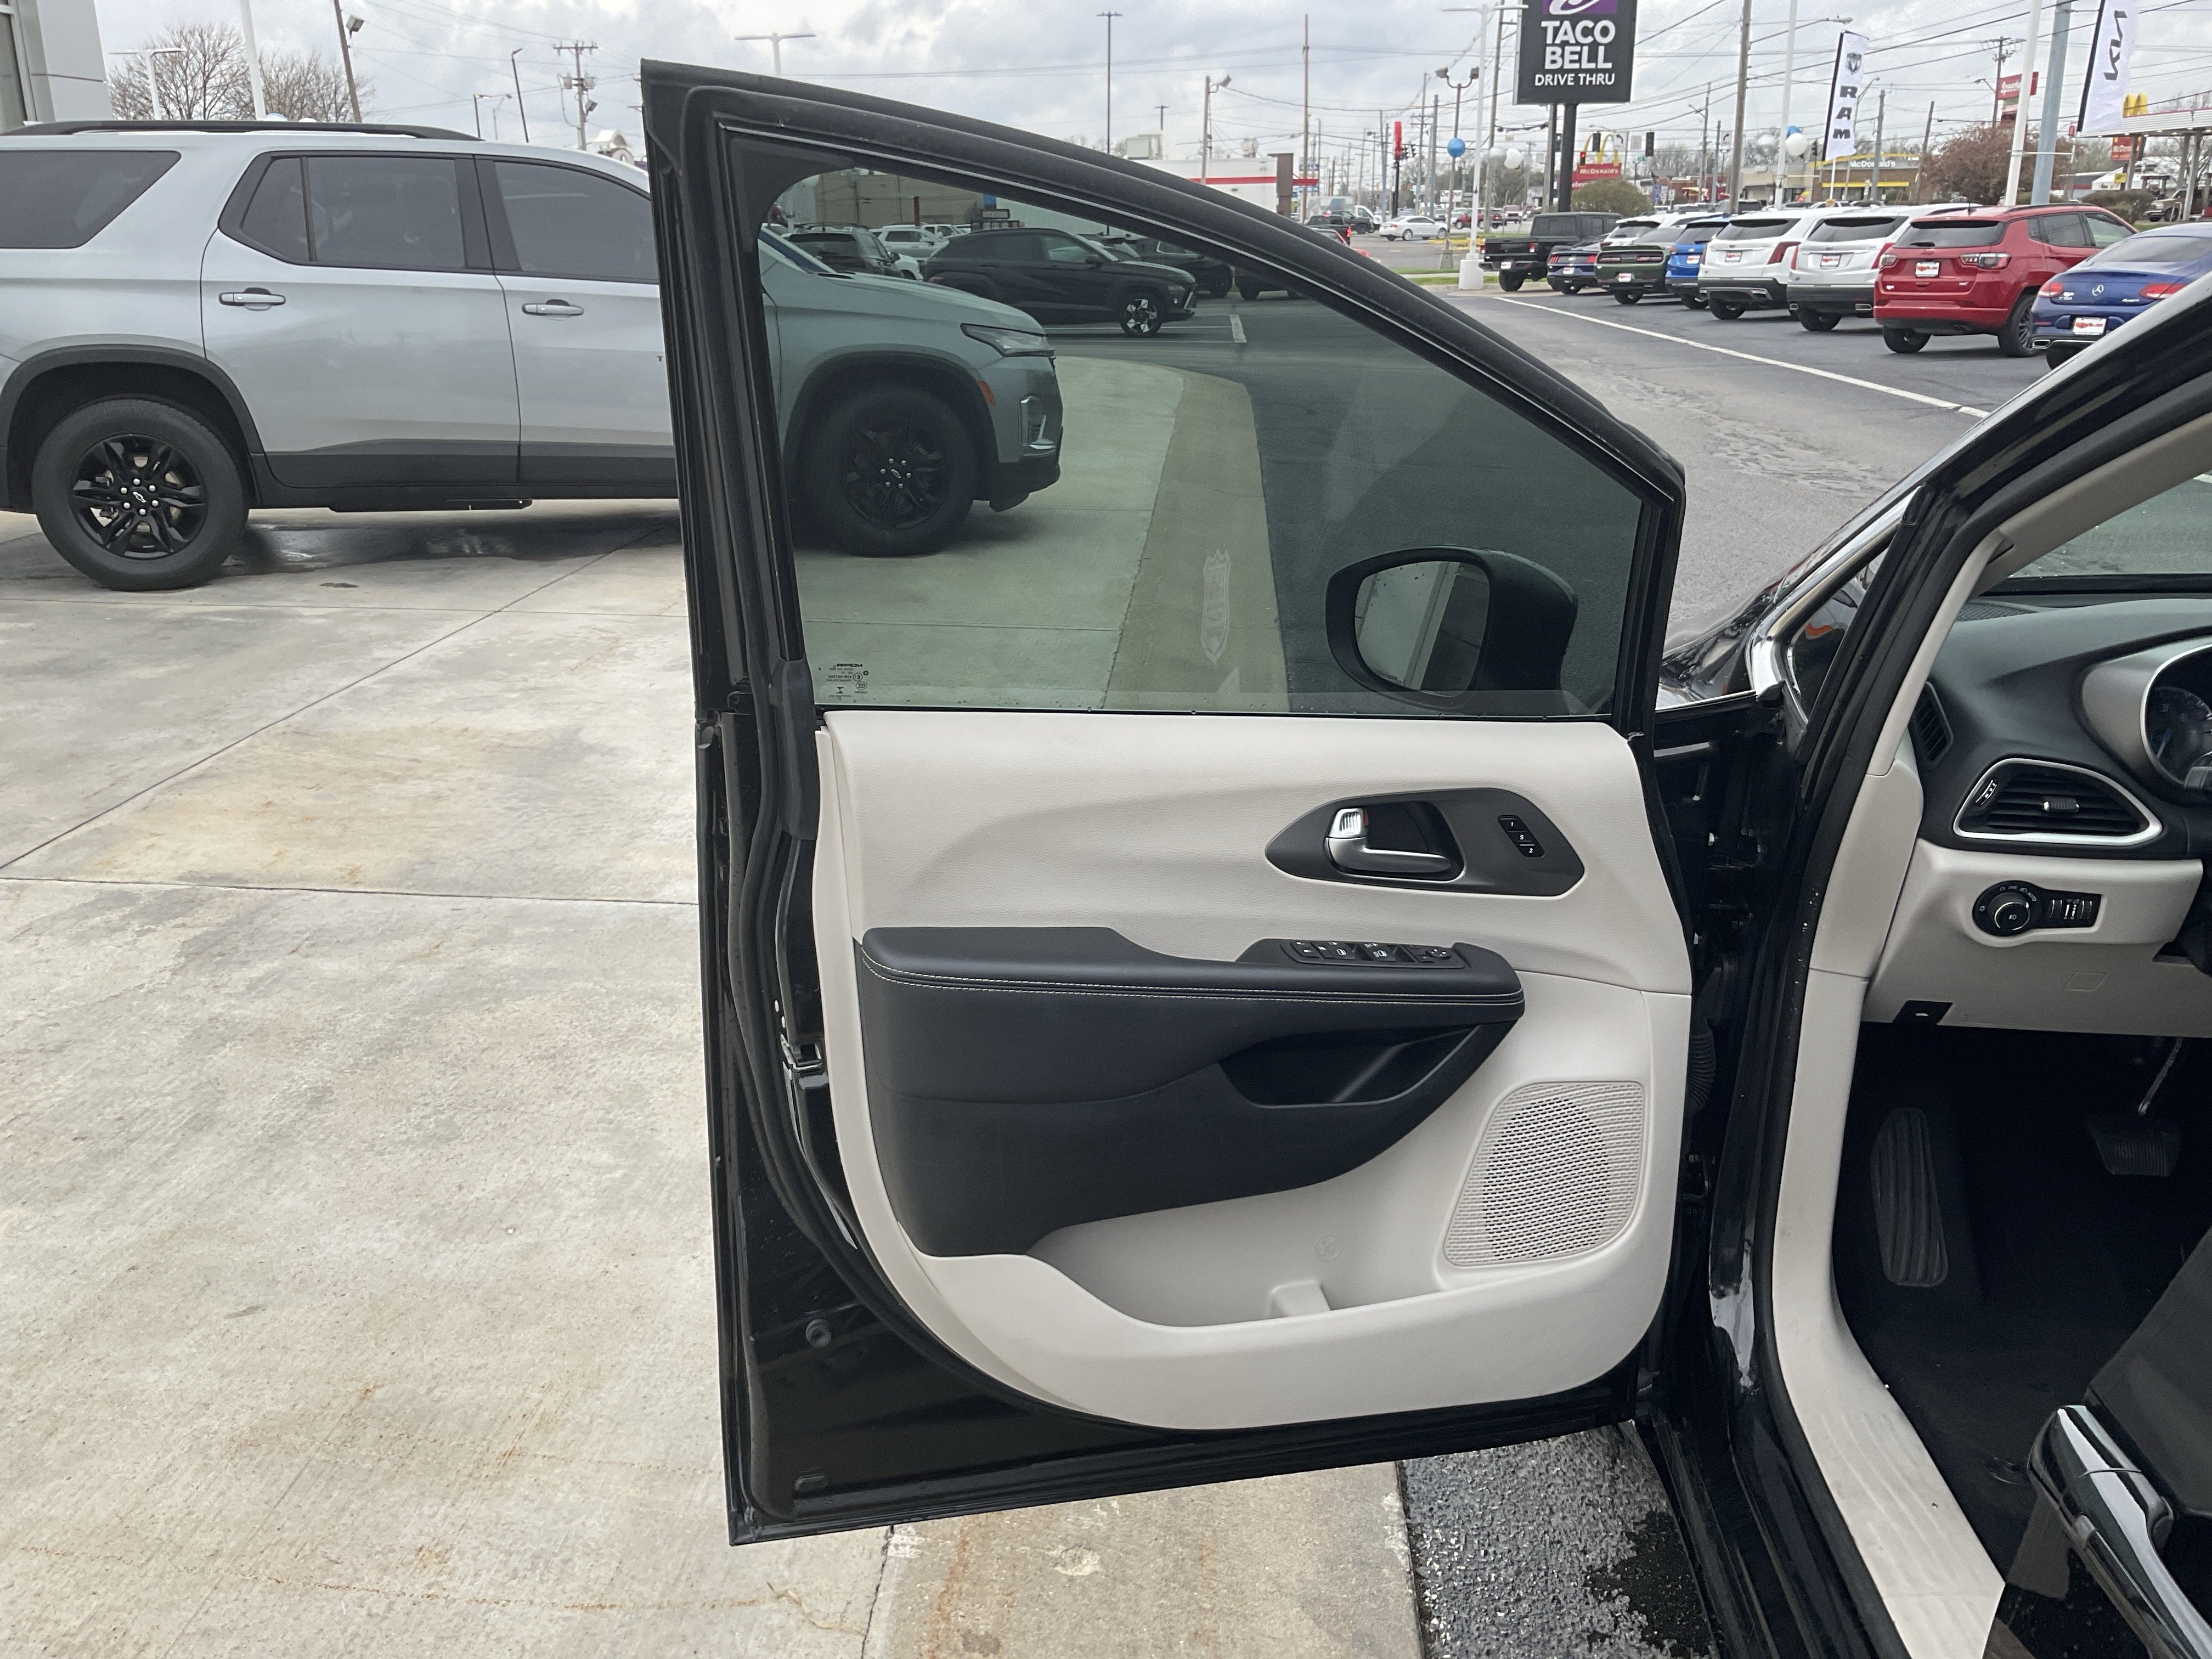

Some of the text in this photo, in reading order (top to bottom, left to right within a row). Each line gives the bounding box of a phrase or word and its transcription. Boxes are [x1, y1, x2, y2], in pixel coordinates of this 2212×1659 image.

[1541, 20, 1616, 44] TACO
[1544, 46, 1612, 69] BELL
[1534, 73, 1615, 86] DRIVE THRU
[1833, 86, 1858, 139] RAM
[2027, 892, 2037, 901] AUTO
